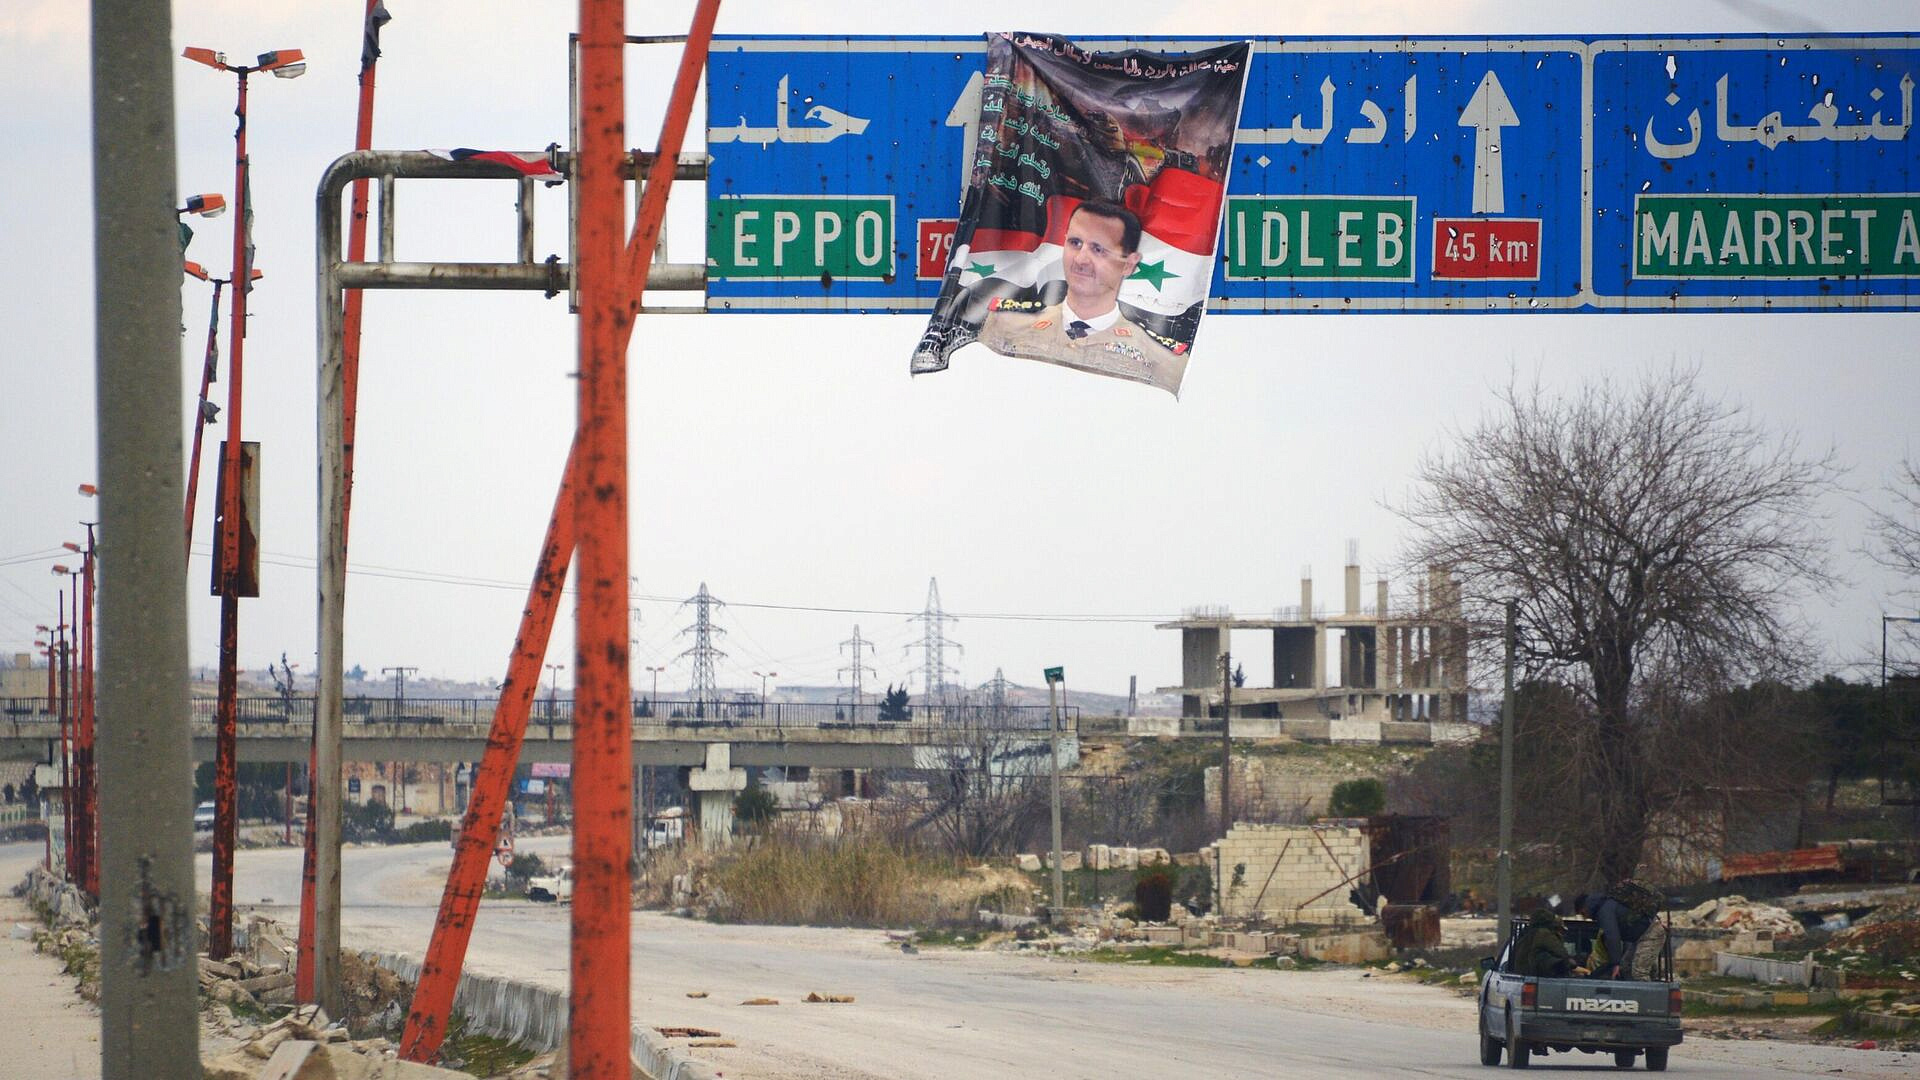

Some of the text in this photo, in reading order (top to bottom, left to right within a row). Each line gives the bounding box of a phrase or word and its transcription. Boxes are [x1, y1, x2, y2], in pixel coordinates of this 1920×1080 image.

[708, 211, 883, 267] EPPO
[1236, 210, 1404, 267] IDLEB
[1445, 232, 1529, 263] 45 km
[1641, 209, 1920, 266] MAARRET A
